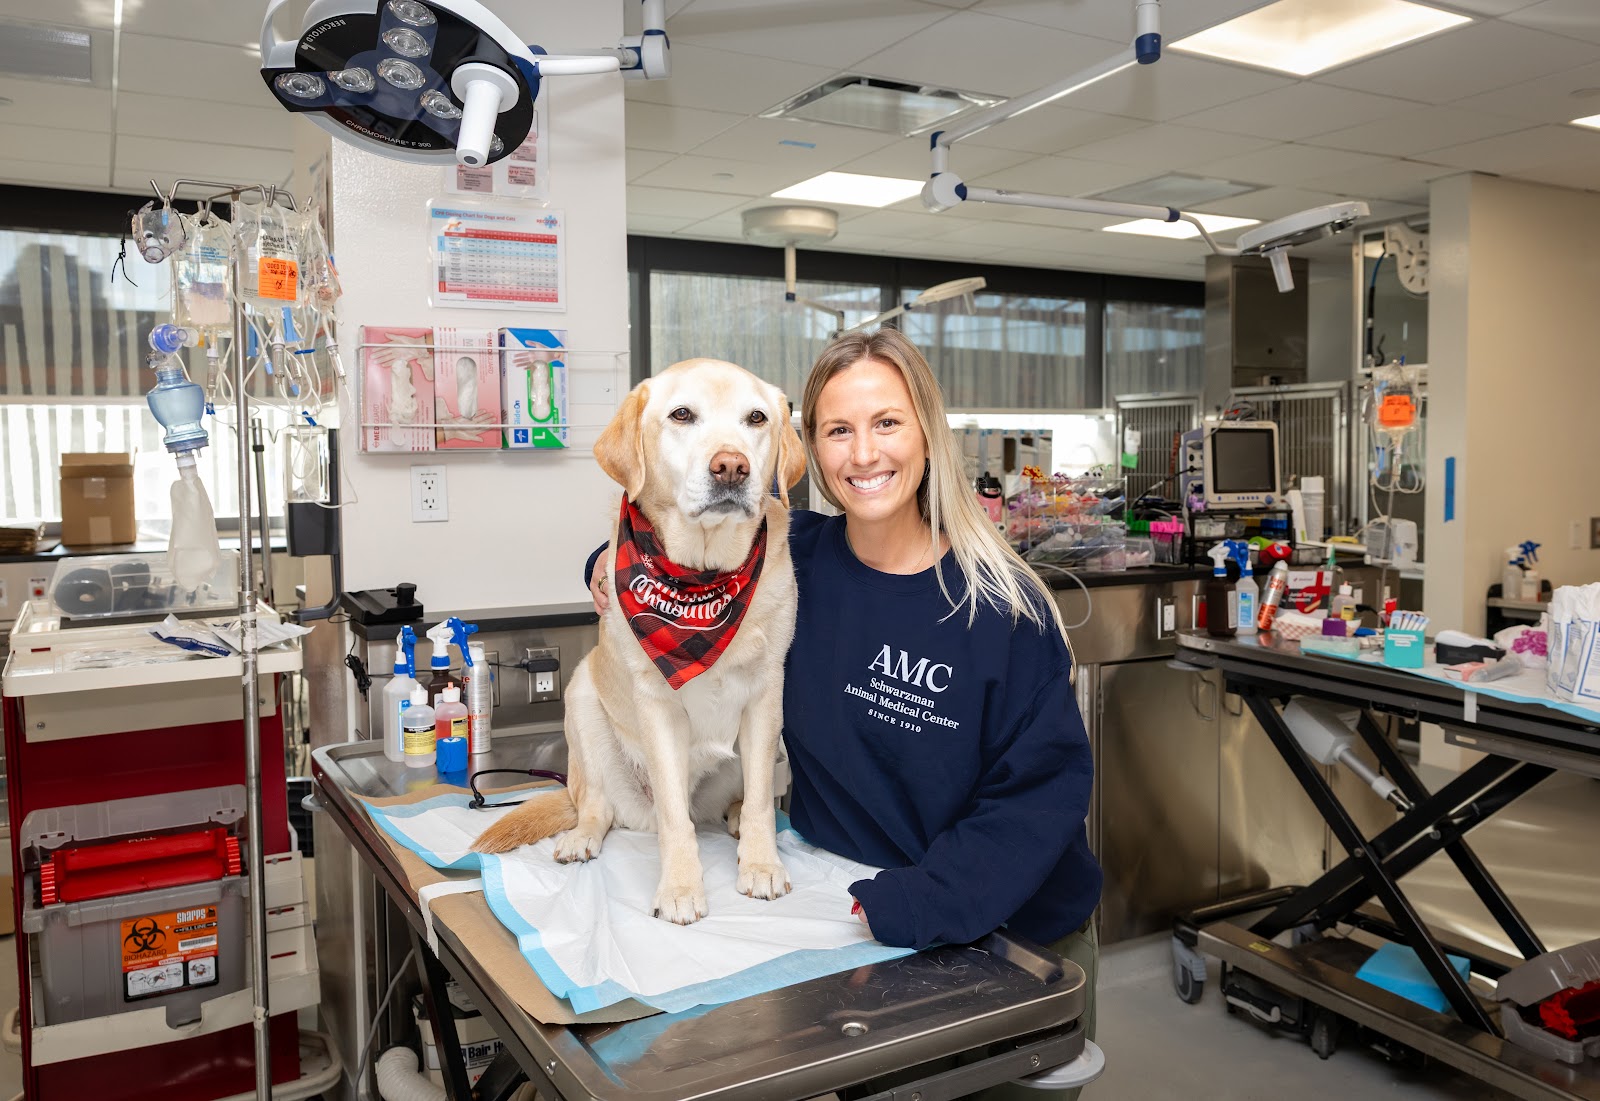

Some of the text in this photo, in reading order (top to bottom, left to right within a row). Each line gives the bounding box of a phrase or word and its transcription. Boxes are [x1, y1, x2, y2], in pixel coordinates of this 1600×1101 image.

[306, 19, 347, 43] BERCHTOLD
[373, 403, 381, 441] MEDGUARD
[534, 431, 546, 440] L
[867, 643, 953, 693] AMC
[869, 677, 935, 709] Schwarzman
[844, 683, 960, 730] Animal Medical Center
[867, 708, 922, 733] SINCE 1910
[124, 948, 167, 962] BIOHAZARD
[468, 1044, 492, 1059] Bair
